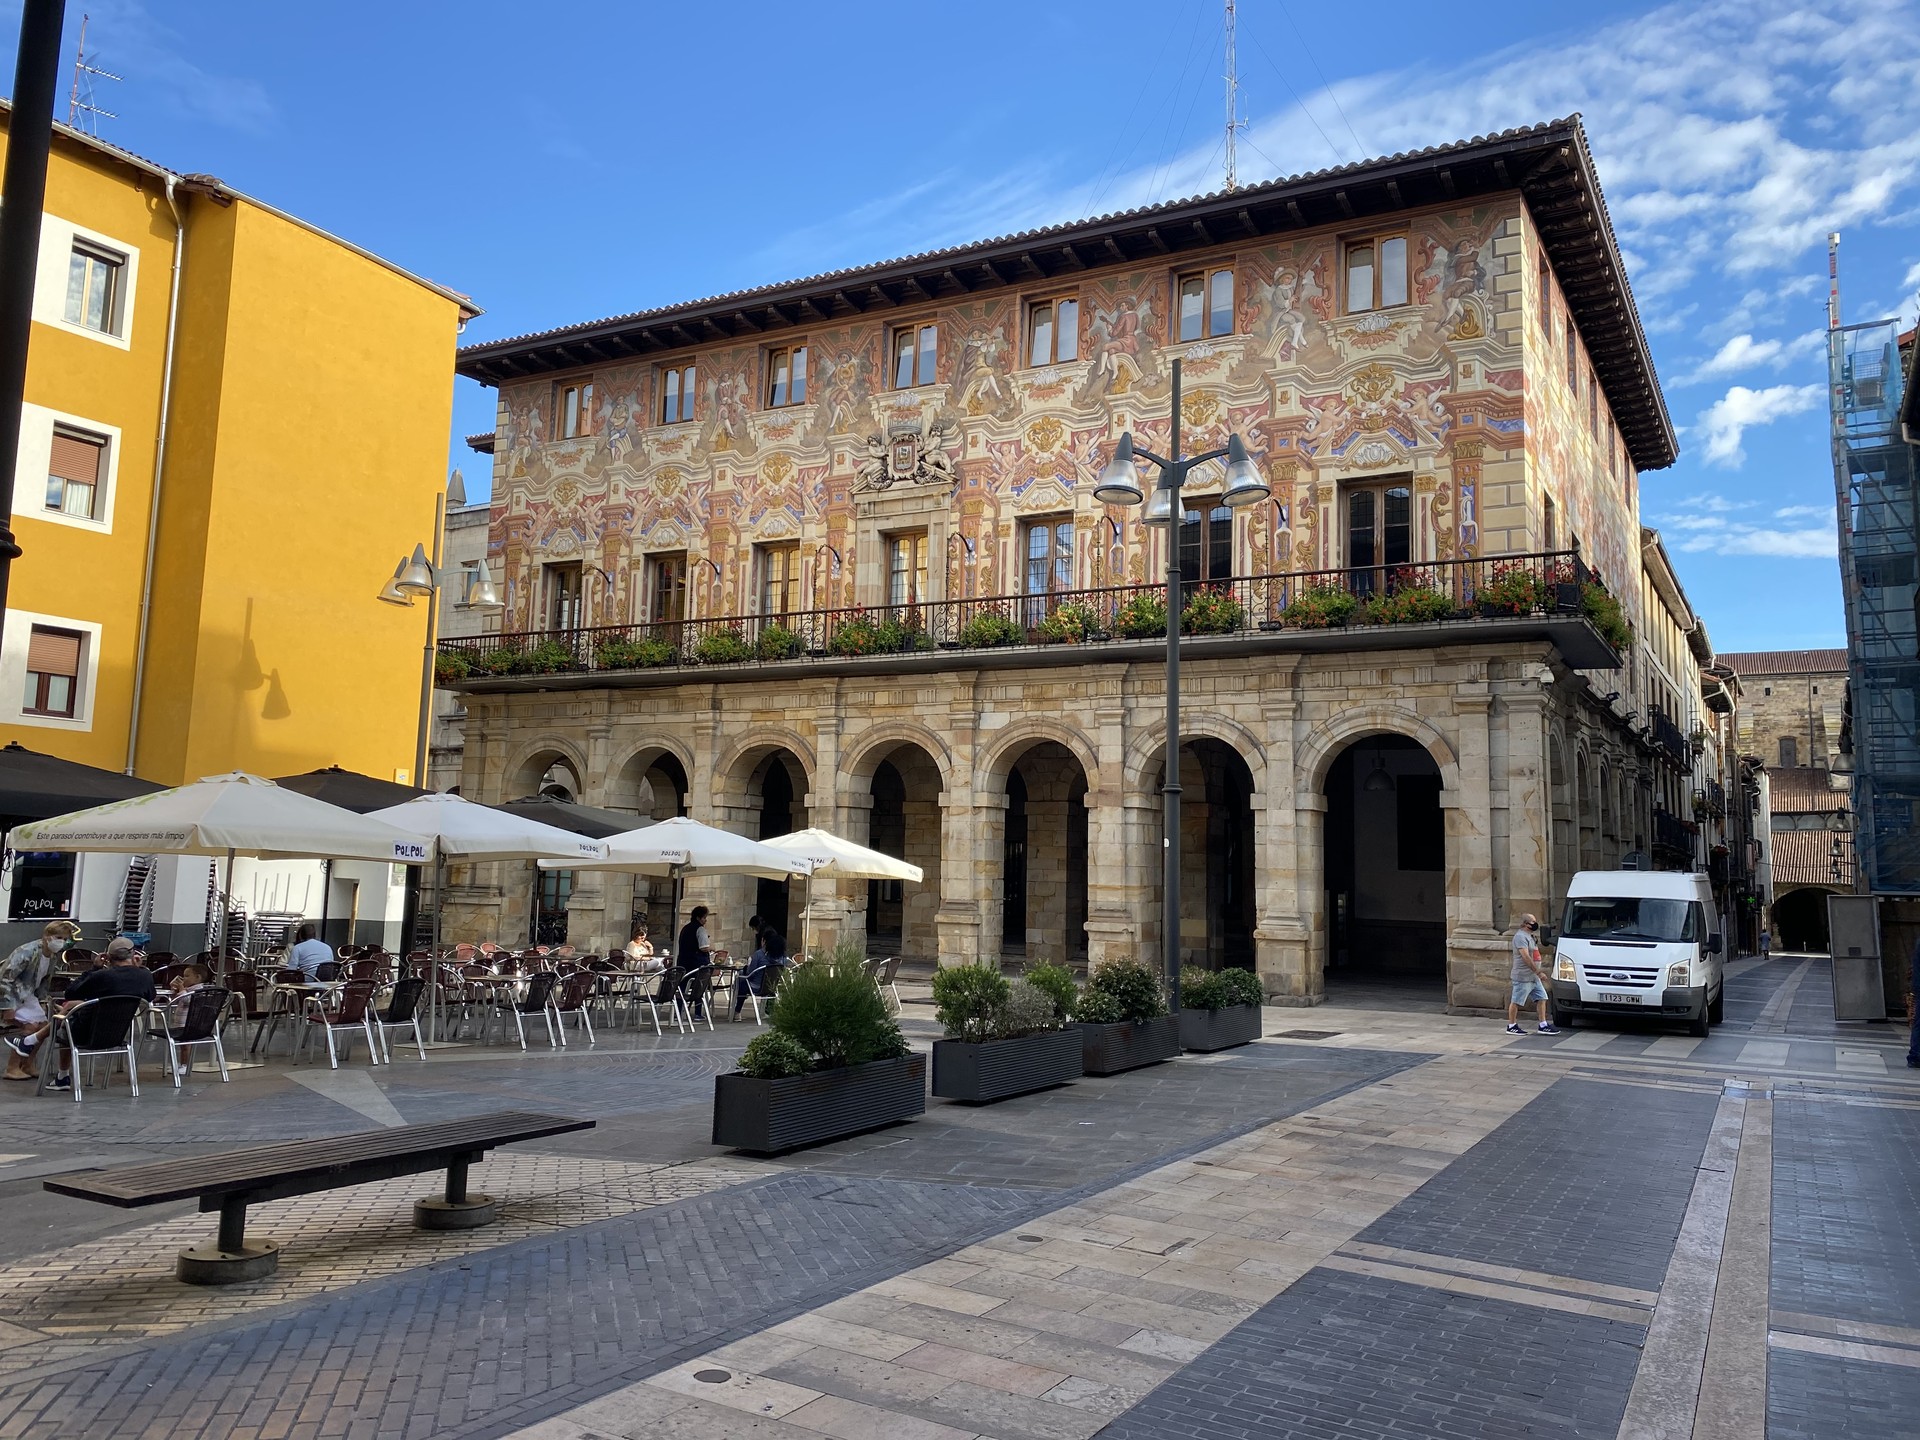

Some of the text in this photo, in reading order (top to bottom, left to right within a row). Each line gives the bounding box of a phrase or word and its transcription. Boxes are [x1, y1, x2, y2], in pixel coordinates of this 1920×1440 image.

[36, 832, 50, 840] Este
[50, 832, 75, 841] parasol
[75, 832, 107, 841] contribuye
[113, 833, 126, 841] que
[150, 831, 164, 840] más
[164, 831, 185, 841] limpio
